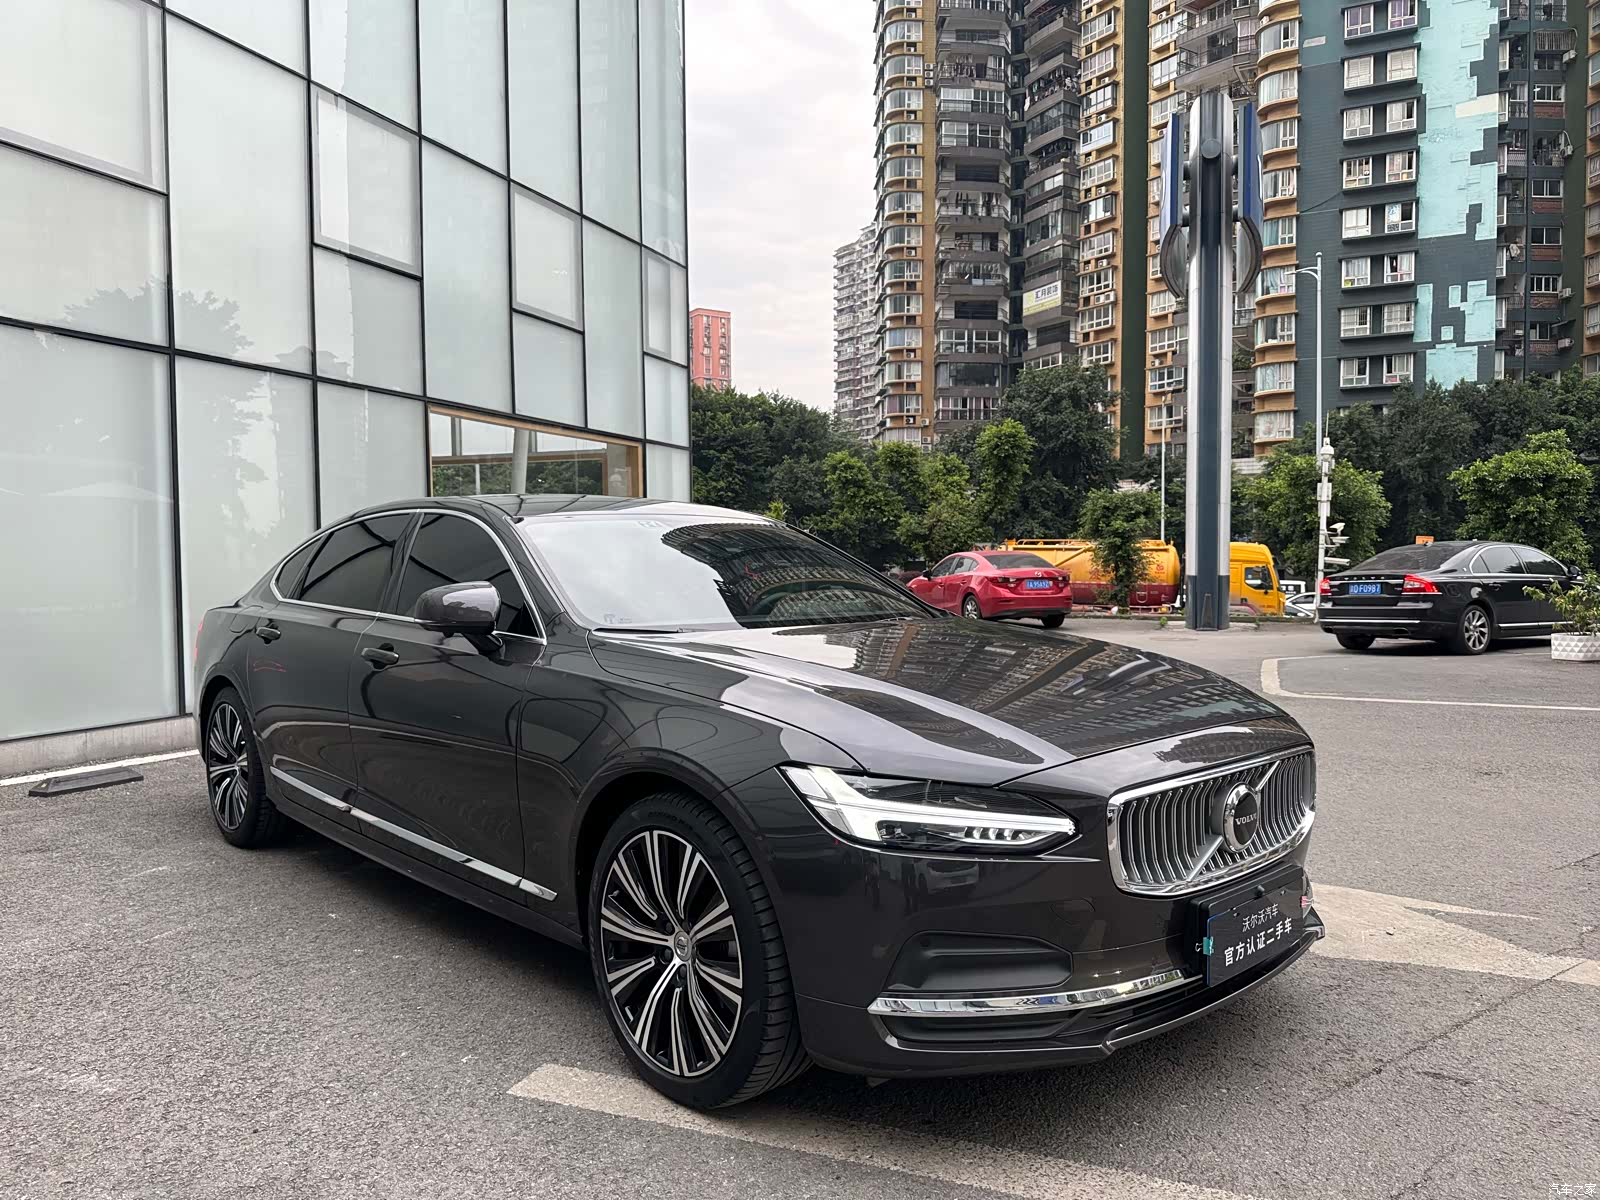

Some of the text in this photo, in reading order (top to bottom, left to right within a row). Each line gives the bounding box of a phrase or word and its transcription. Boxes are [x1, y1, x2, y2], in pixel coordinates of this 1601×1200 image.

[1242, 903, 1279, 932] 沃尔沃汽车
[1224, 917, 1292, 967] 官方认证二手车
